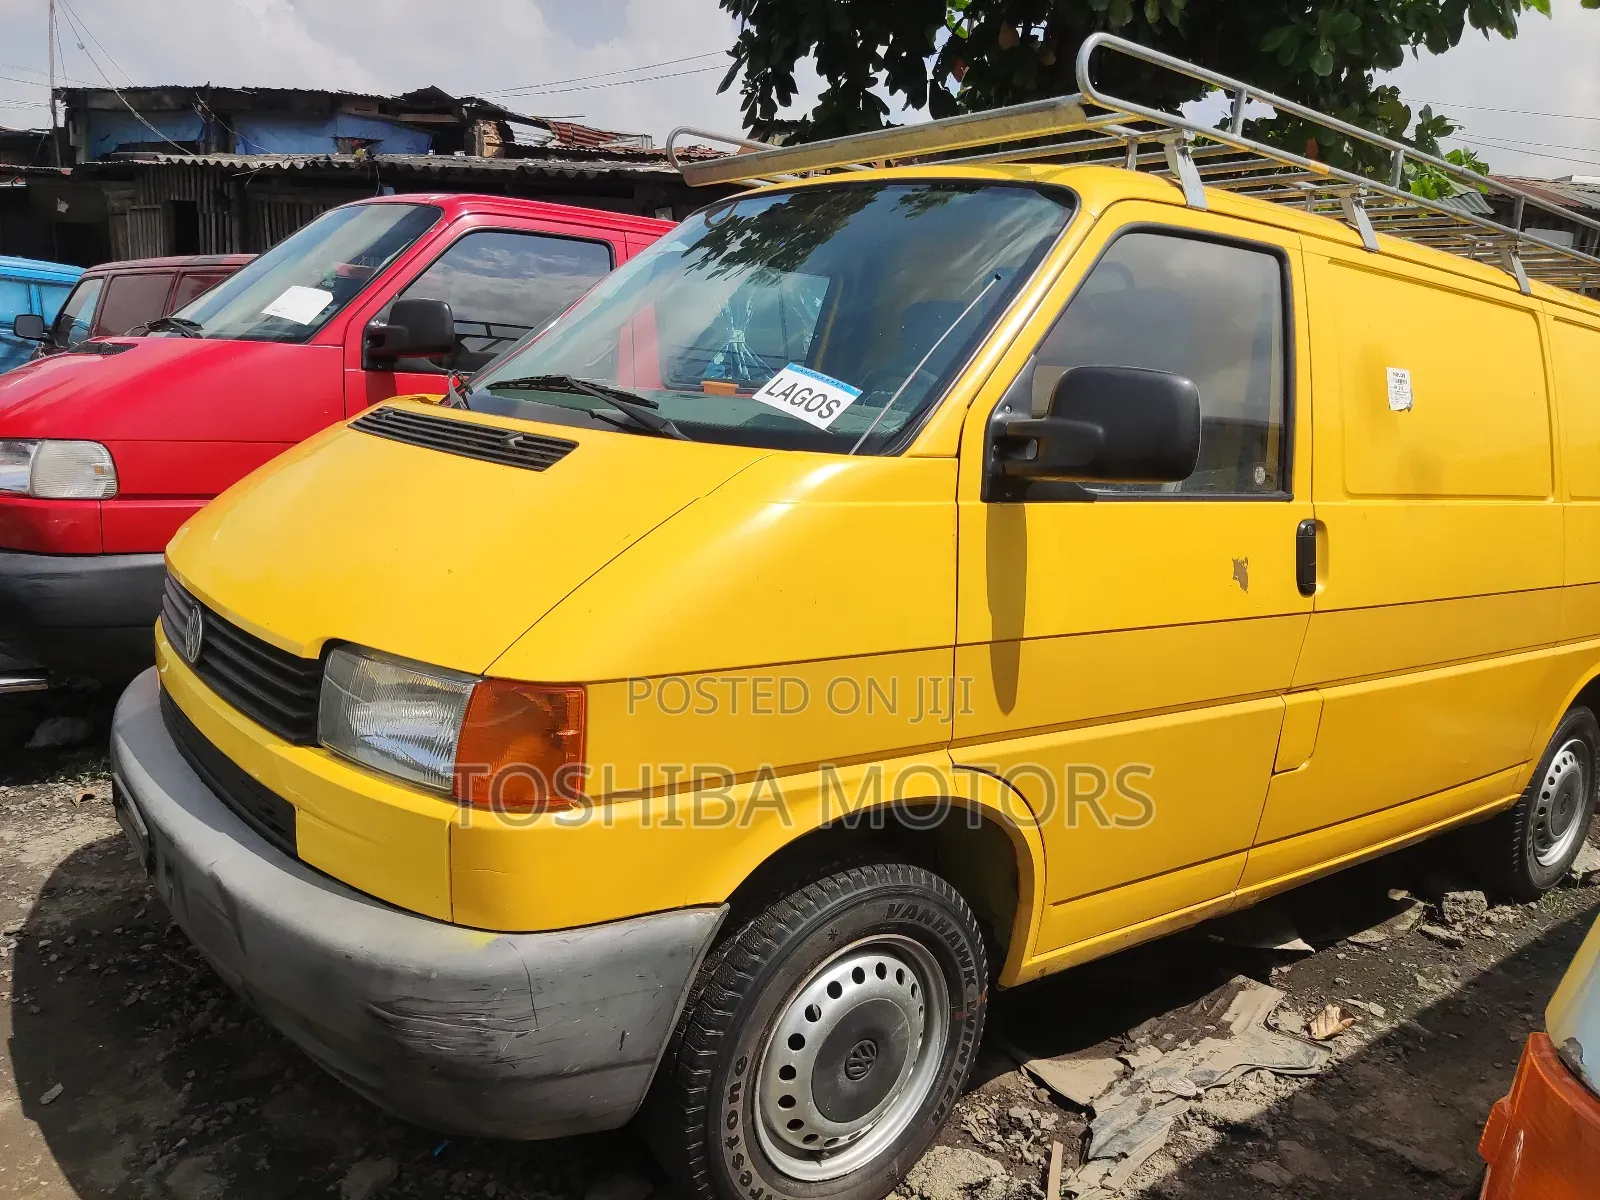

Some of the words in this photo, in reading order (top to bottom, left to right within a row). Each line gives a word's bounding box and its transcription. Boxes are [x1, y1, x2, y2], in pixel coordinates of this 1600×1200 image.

[765, 377, 841, 419] LAGOS
[884, 903, 978, 989] VANHAWK
[725, 1055, 788, 1200] restone
